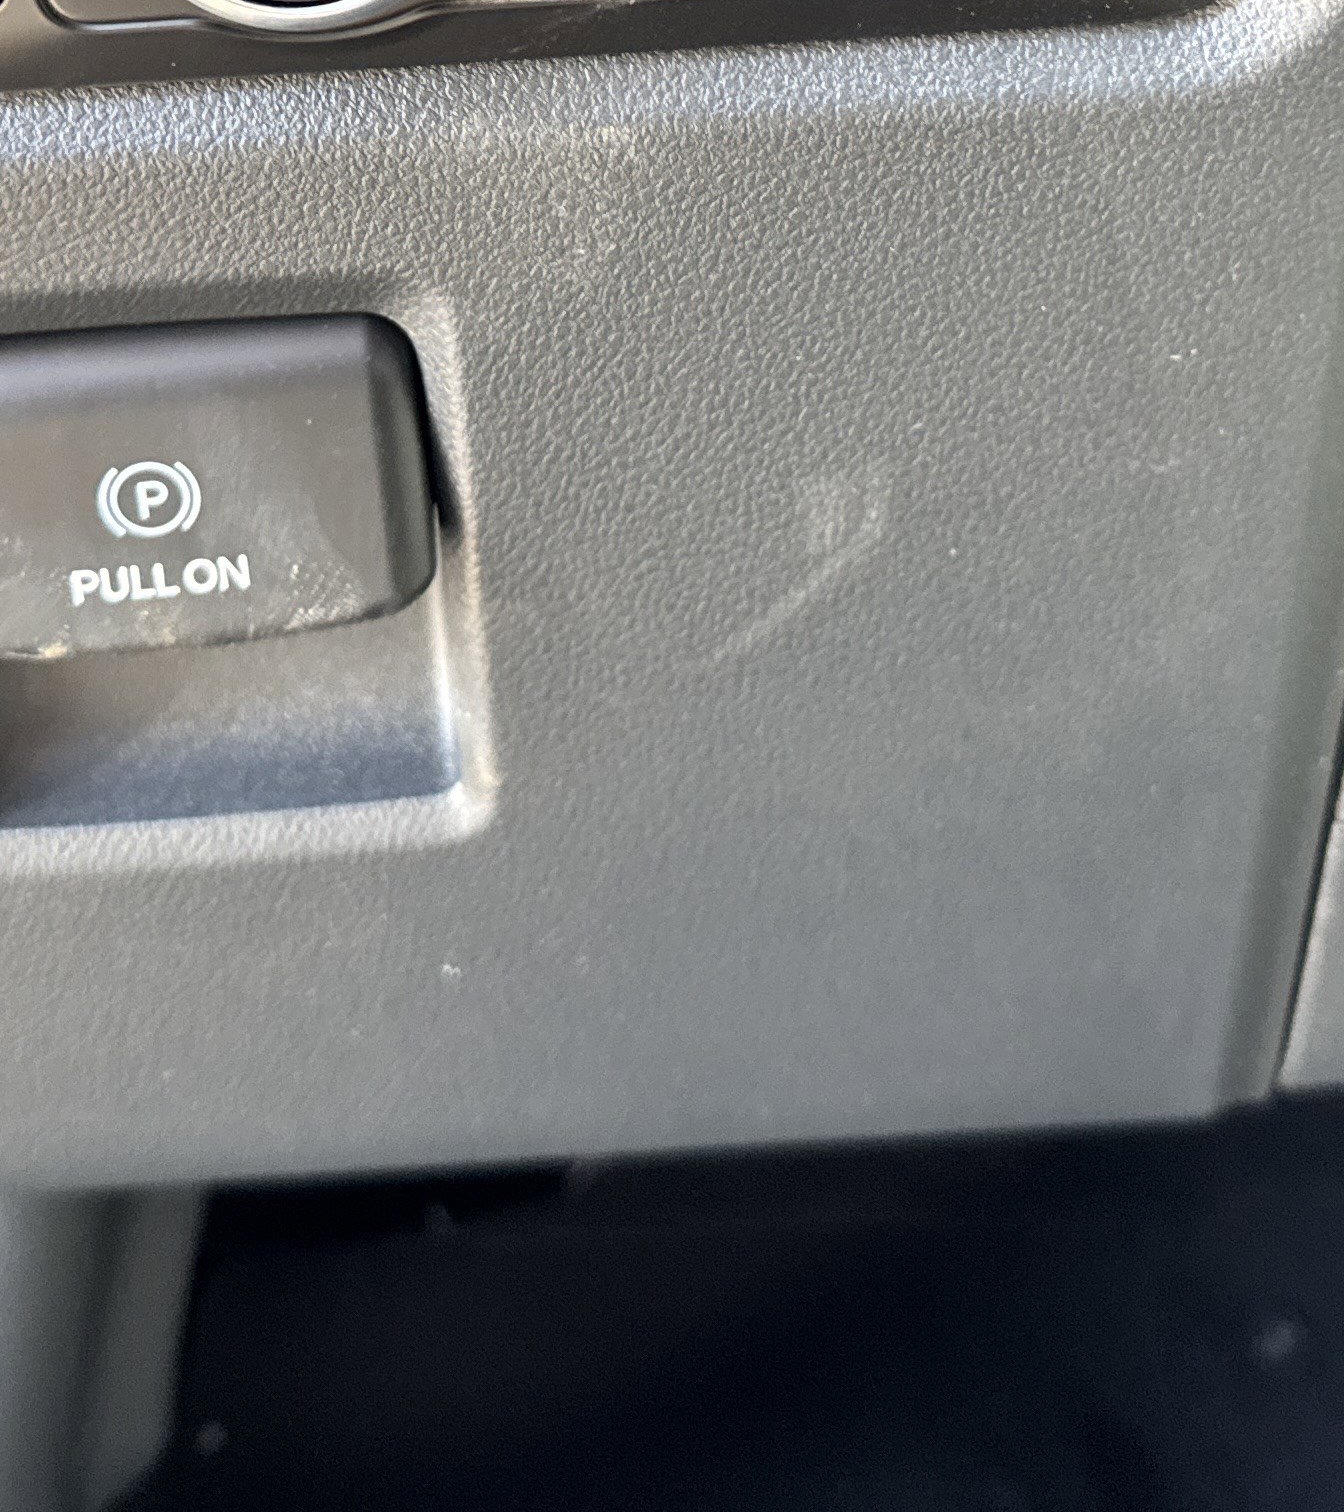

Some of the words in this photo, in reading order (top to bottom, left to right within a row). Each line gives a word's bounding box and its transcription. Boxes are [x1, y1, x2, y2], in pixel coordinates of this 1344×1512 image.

[136, 480, 169, 520] P
[69, 562, 181, 607] PULL
[182, 553, 251, 595] ON
